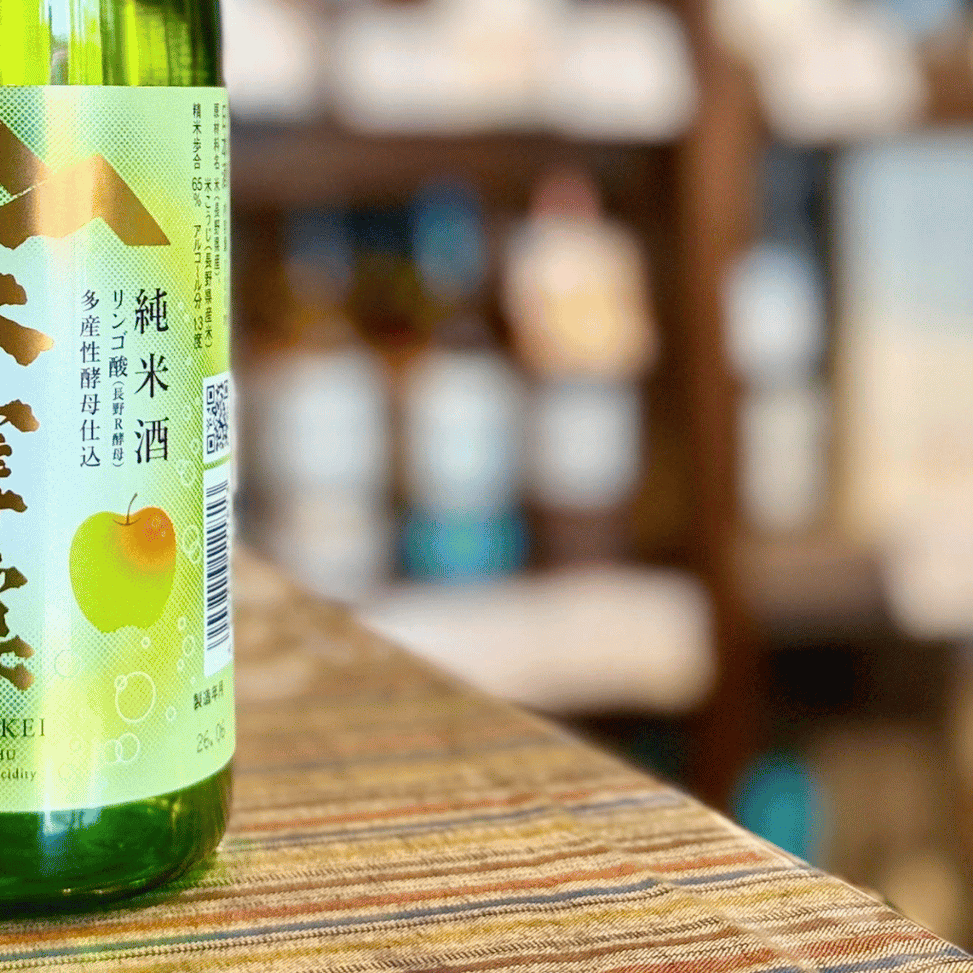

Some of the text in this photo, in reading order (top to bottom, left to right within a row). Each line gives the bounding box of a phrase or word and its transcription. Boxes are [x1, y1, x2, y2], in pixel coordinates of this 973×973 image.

[192, 102, 202, 170] 精米歩合
[193, 224, 202, 310] アルコール分
[79, 289, 102, 468] 多産性酵母仕込
[133, 287, 170, 465] 純米酒
